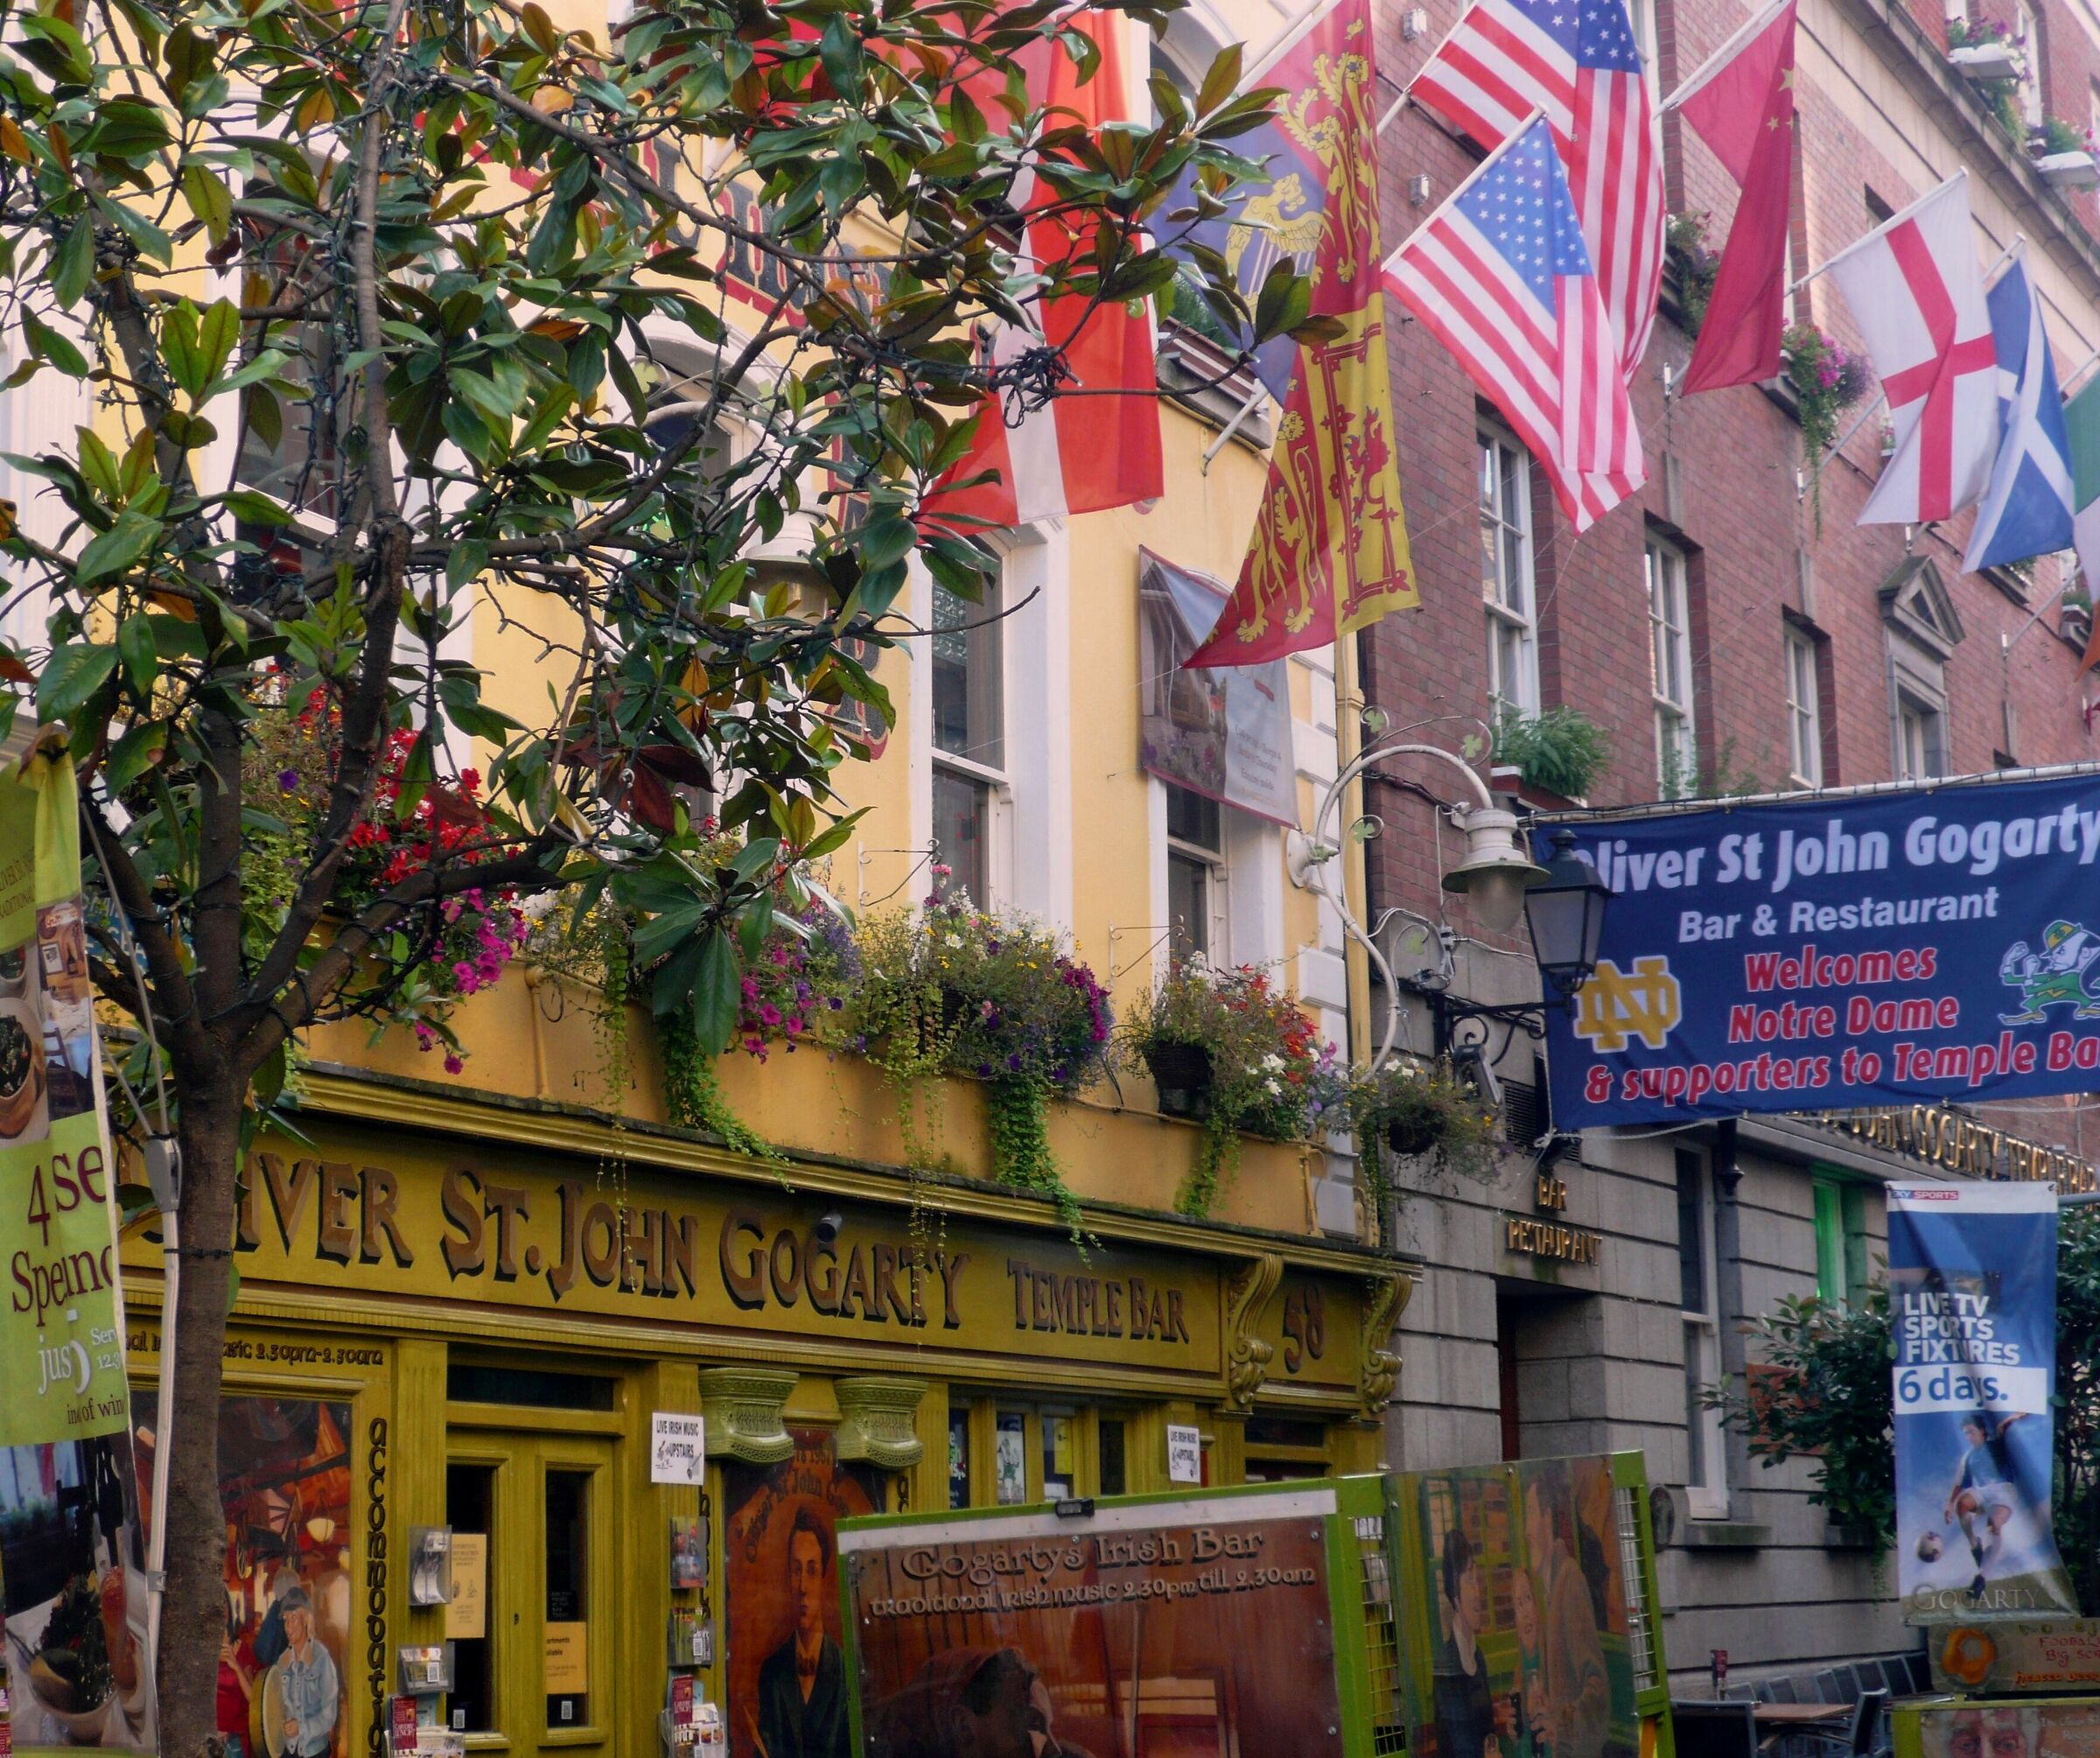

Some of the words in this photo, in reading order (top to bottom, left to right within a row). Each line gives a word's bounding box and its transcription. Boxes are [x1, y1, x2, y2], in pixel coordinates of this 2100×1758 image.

[1573, 839, 1706, 893] liver
[1717, 832, 1763, 883] St
[1771, 819, 1890, 893] John
[1678, 911, 1742, 943] Bar
[1752, 904, 1777, 936] &
[1789, 886, 1999, 934] Restaurant
[1745, 946, 1937, 992] Welcomes
[1728, 1004, 1835, 1044] Notre
[1847, 996, 1959, 1036] Dame
[1584, 1064, 1614, 1103] &
[1621, 1052, 1830, 1108] supporters
[1842, 1050, 1881, 1087] to
[1893, 1030, 2036, 1088] Temple
[2047, 1033, 2100, 1073] Ba
[1537, 1175, 1567, 1212] BAR
[233, 1152, 415, 1269] IVER
[545, 1179, 699, 1304] JOHN
[719, 1206, 971, 1331] GOGARTY
[1008, 1257, 1124, 1337] TEMPLE
[1130, 1277, 1190, 1344] BAR
[1282, 1285, 1326, 1373] 58
[1904, 1292, 1950, 1316] LIVE
[1955, 1294, 1990, 1317] TV
[1905, 1316, 1994, 1341] SPORTS
[223, 1339, 253, 1360] usic
[1898, 1369, 1922, 1404] 6
[81, 1397, 95, 1421] of
[97, 1394, 125, 1418] win
[656, 1419, 668, 1434] LIVE
[683, 1422, 699, 1437] MUSIC
[1096, 1531, 1184, 1569] Irish
[1192, 1527, 1264, 1563] Bar
[367, 1417, 387, 1758] accommodatio
[1053, 1580, 1120, 1608] music
[1122, 1578, 1199, 1603] 2.30pm
[1198, 1568, 1231, 1594] till
